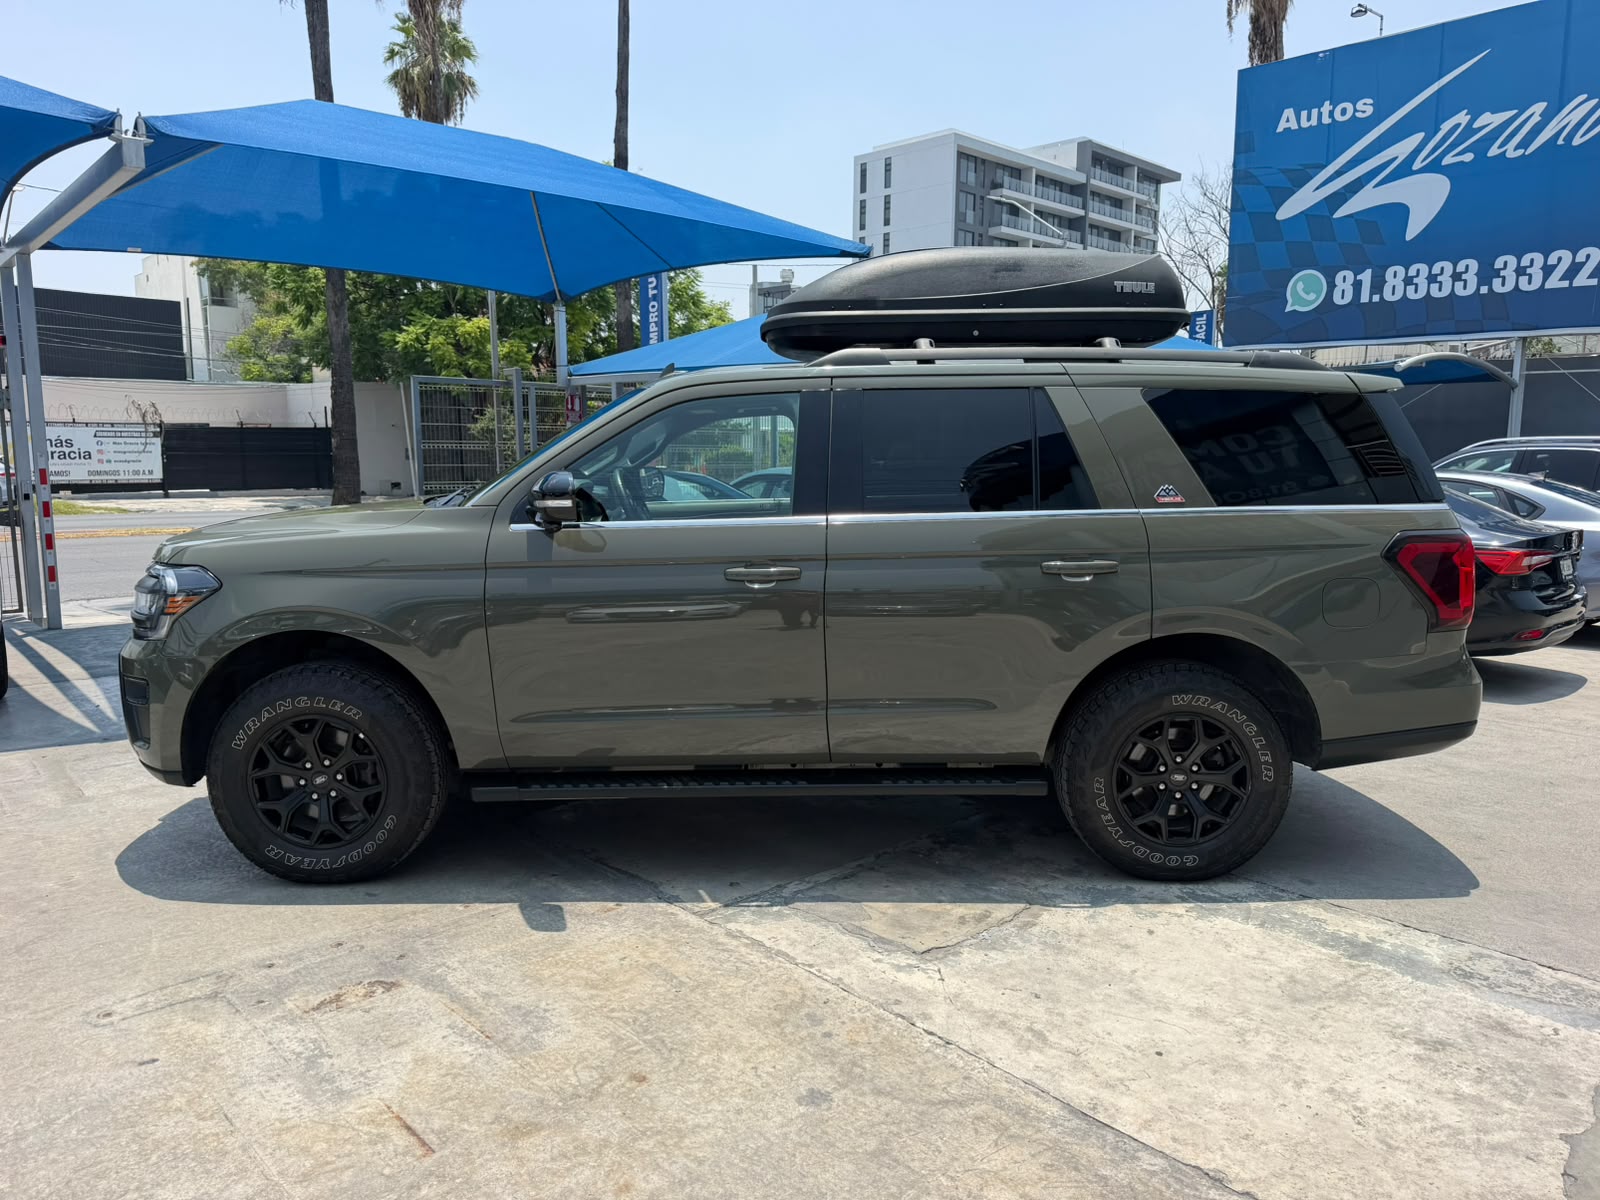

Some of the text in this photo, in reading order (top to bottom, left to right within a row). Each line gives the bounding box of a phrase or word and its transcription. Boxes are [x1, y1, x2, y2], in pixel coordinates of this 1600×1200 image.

[1276, 98, 1374, 133] Autos
[648, 276, 658, 298] TU
[1114, 281, 1155, 293] THULE
[1332, 246, 1600, 305] 81.8333.3322
[87, 469, 120, 477] DOMINGOS
[232, 696, 363, 750] WRANGLER
[1172, 695, 1273, 782] WRANGLER
